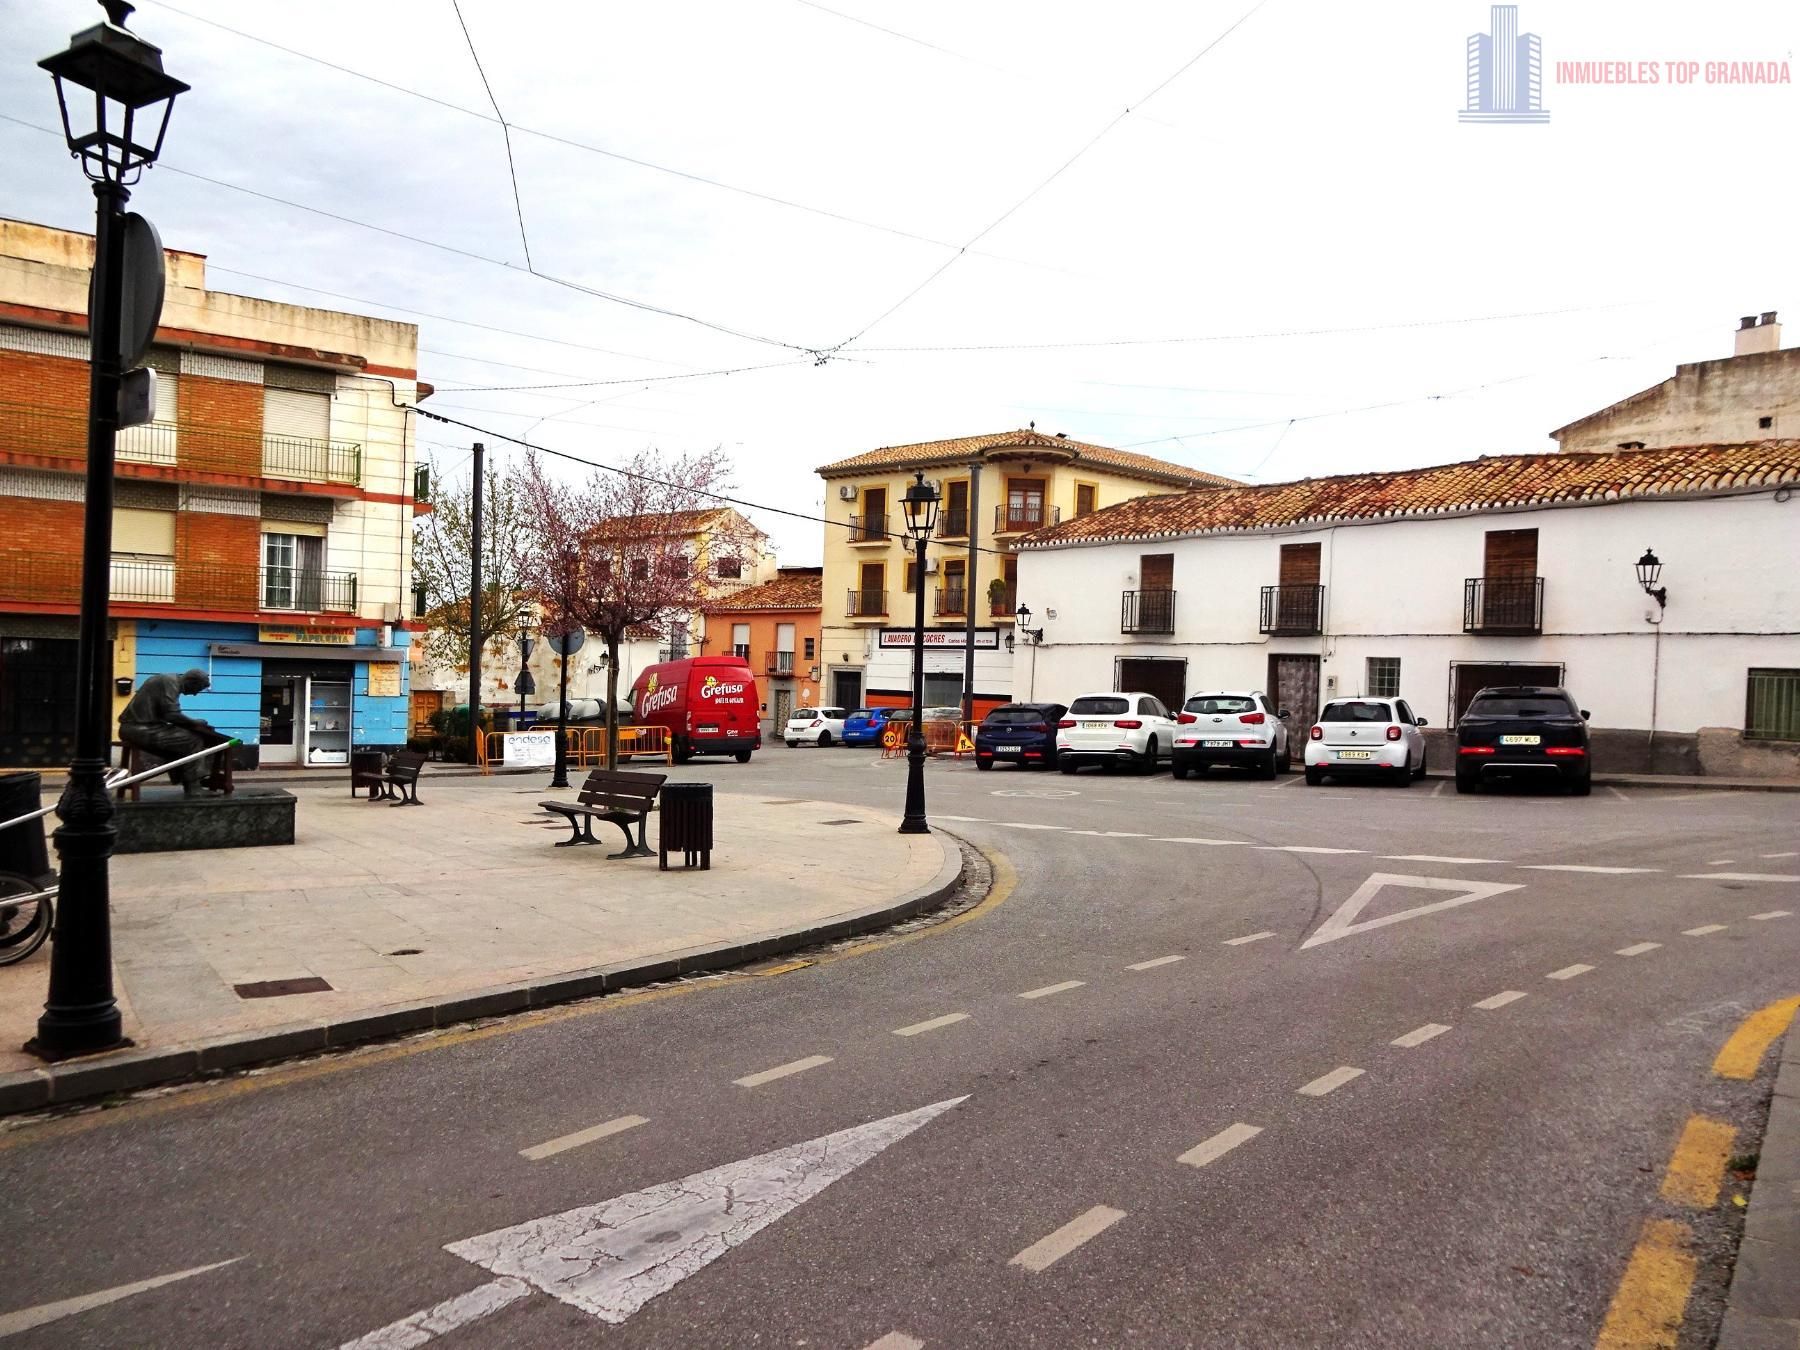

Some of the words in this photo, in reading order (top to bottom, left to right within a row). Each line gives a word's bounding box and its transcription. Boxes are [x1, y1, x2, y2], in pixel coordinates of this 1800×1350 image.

[883, 634, 912, 643] LAVADERO
[923, 634, 946, 643] COCHES
[701, 683, 743, 698] Grefusa
[641, 685, 678, 718] Grefusa
[508, 735, 551, 744] endesa
